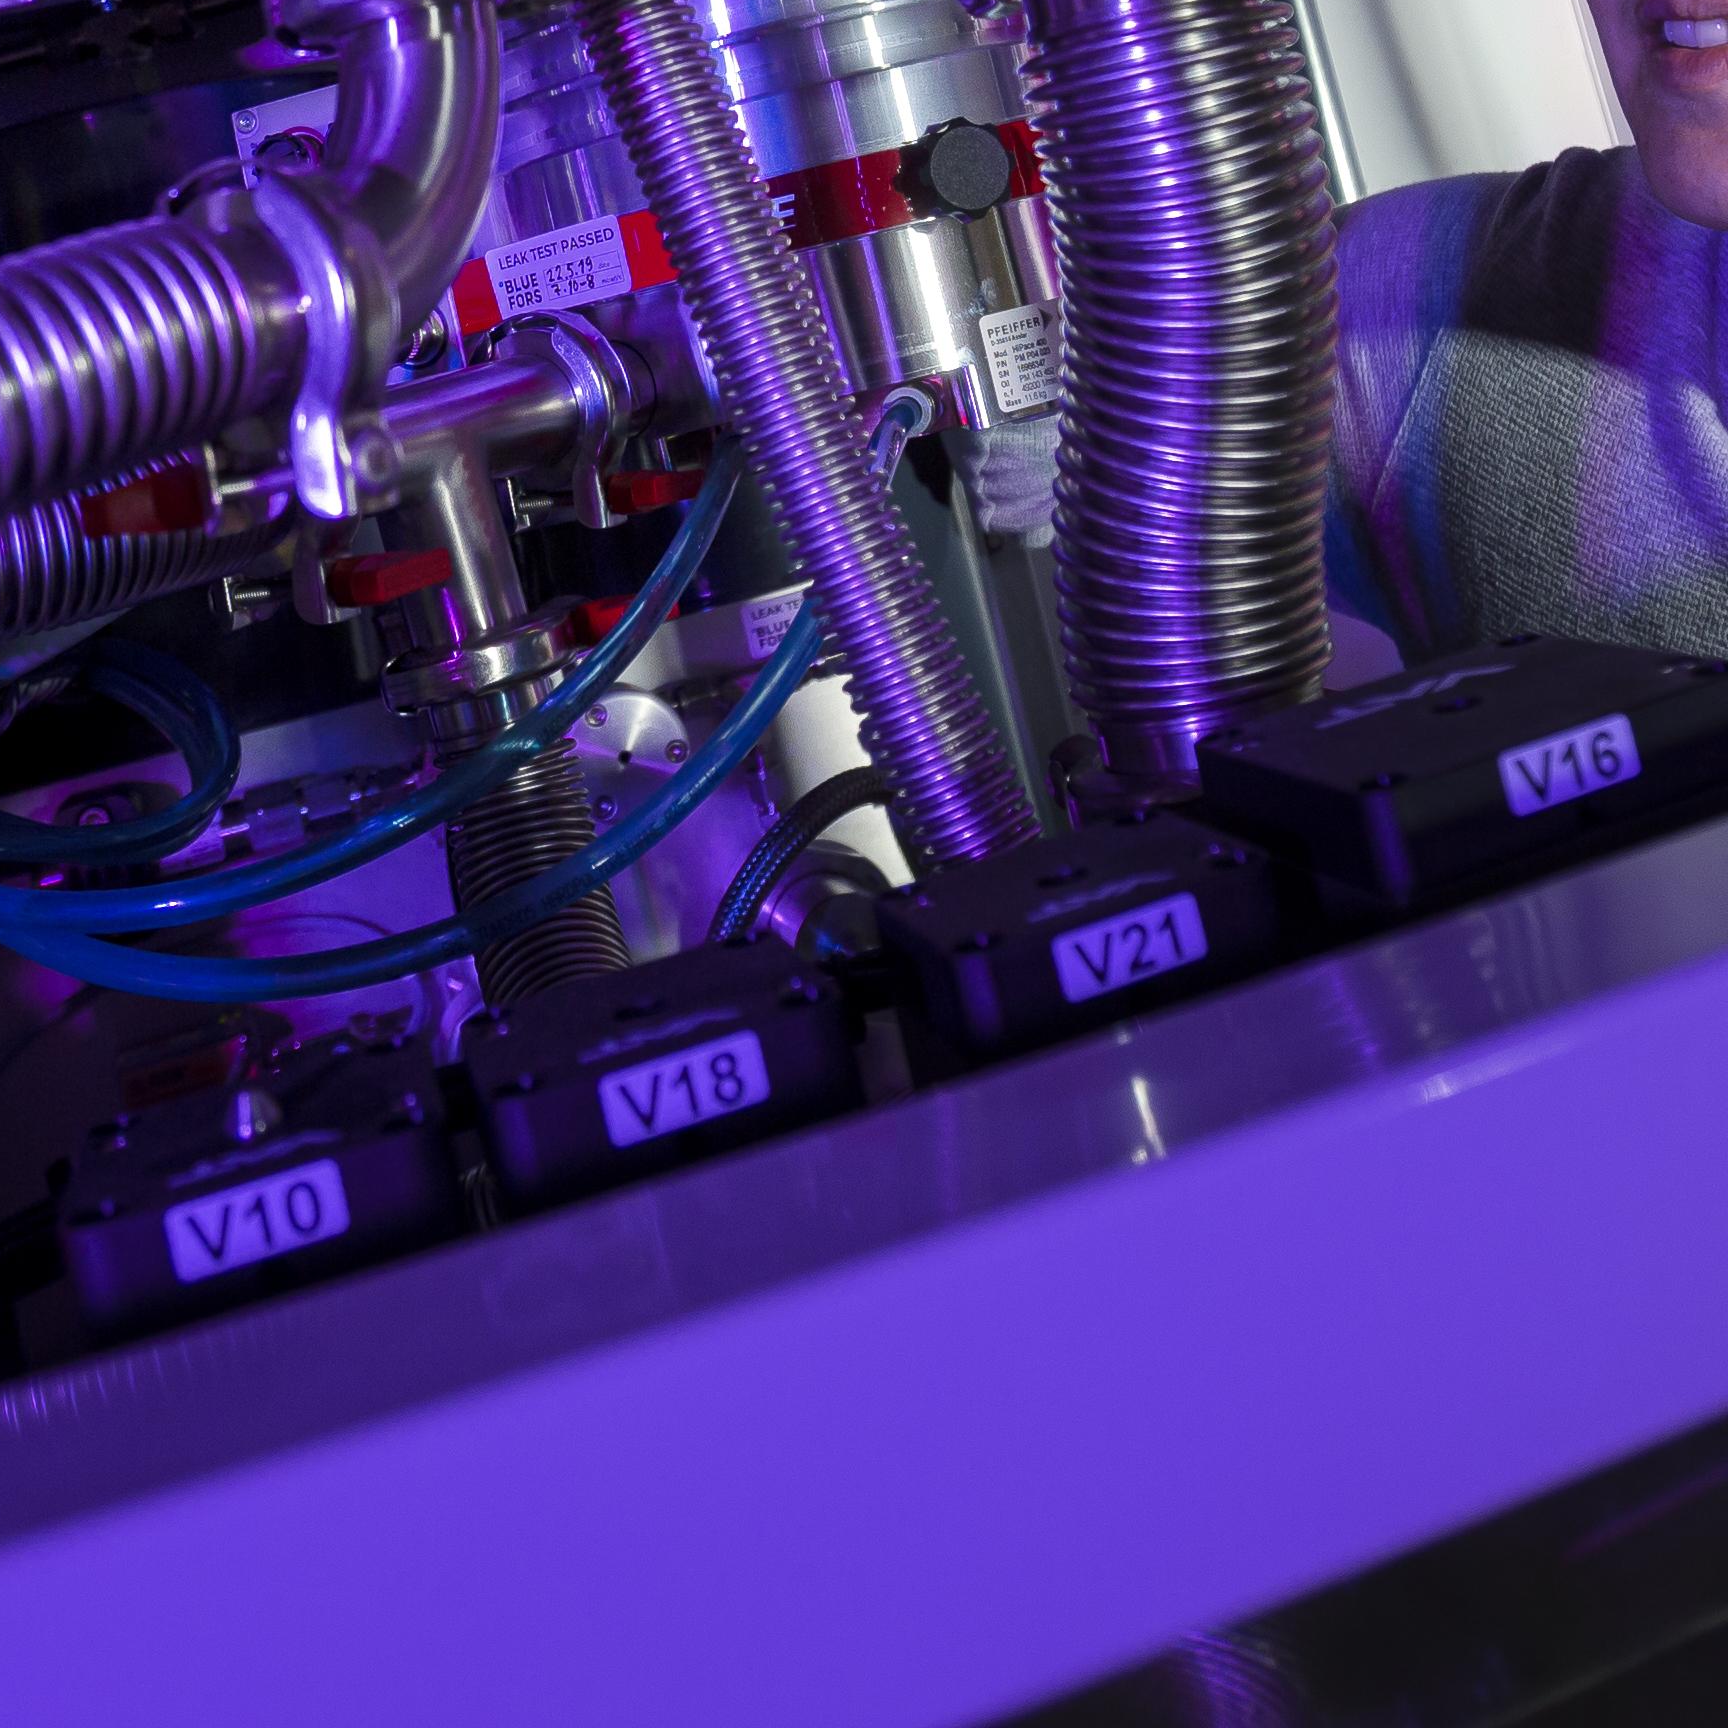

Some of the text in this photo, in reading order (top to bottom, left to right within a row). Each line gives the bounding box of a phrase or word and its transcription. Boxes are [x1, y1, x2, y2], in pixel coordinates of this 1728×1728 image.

[498, 227, 615, 270] LEAK TEST PASSED
[508, 288, 543, 311] FORS
[987, 317, 1040, 338] PFEIFFER
[751, 598, 803, 621] LEAK TE
[1516, 731, 1621, 802] V16
[1074, 910, 1184, 986] V21
[619, 1051, 744, 1133] V18
[185, 1180, 322, 1261] V10
